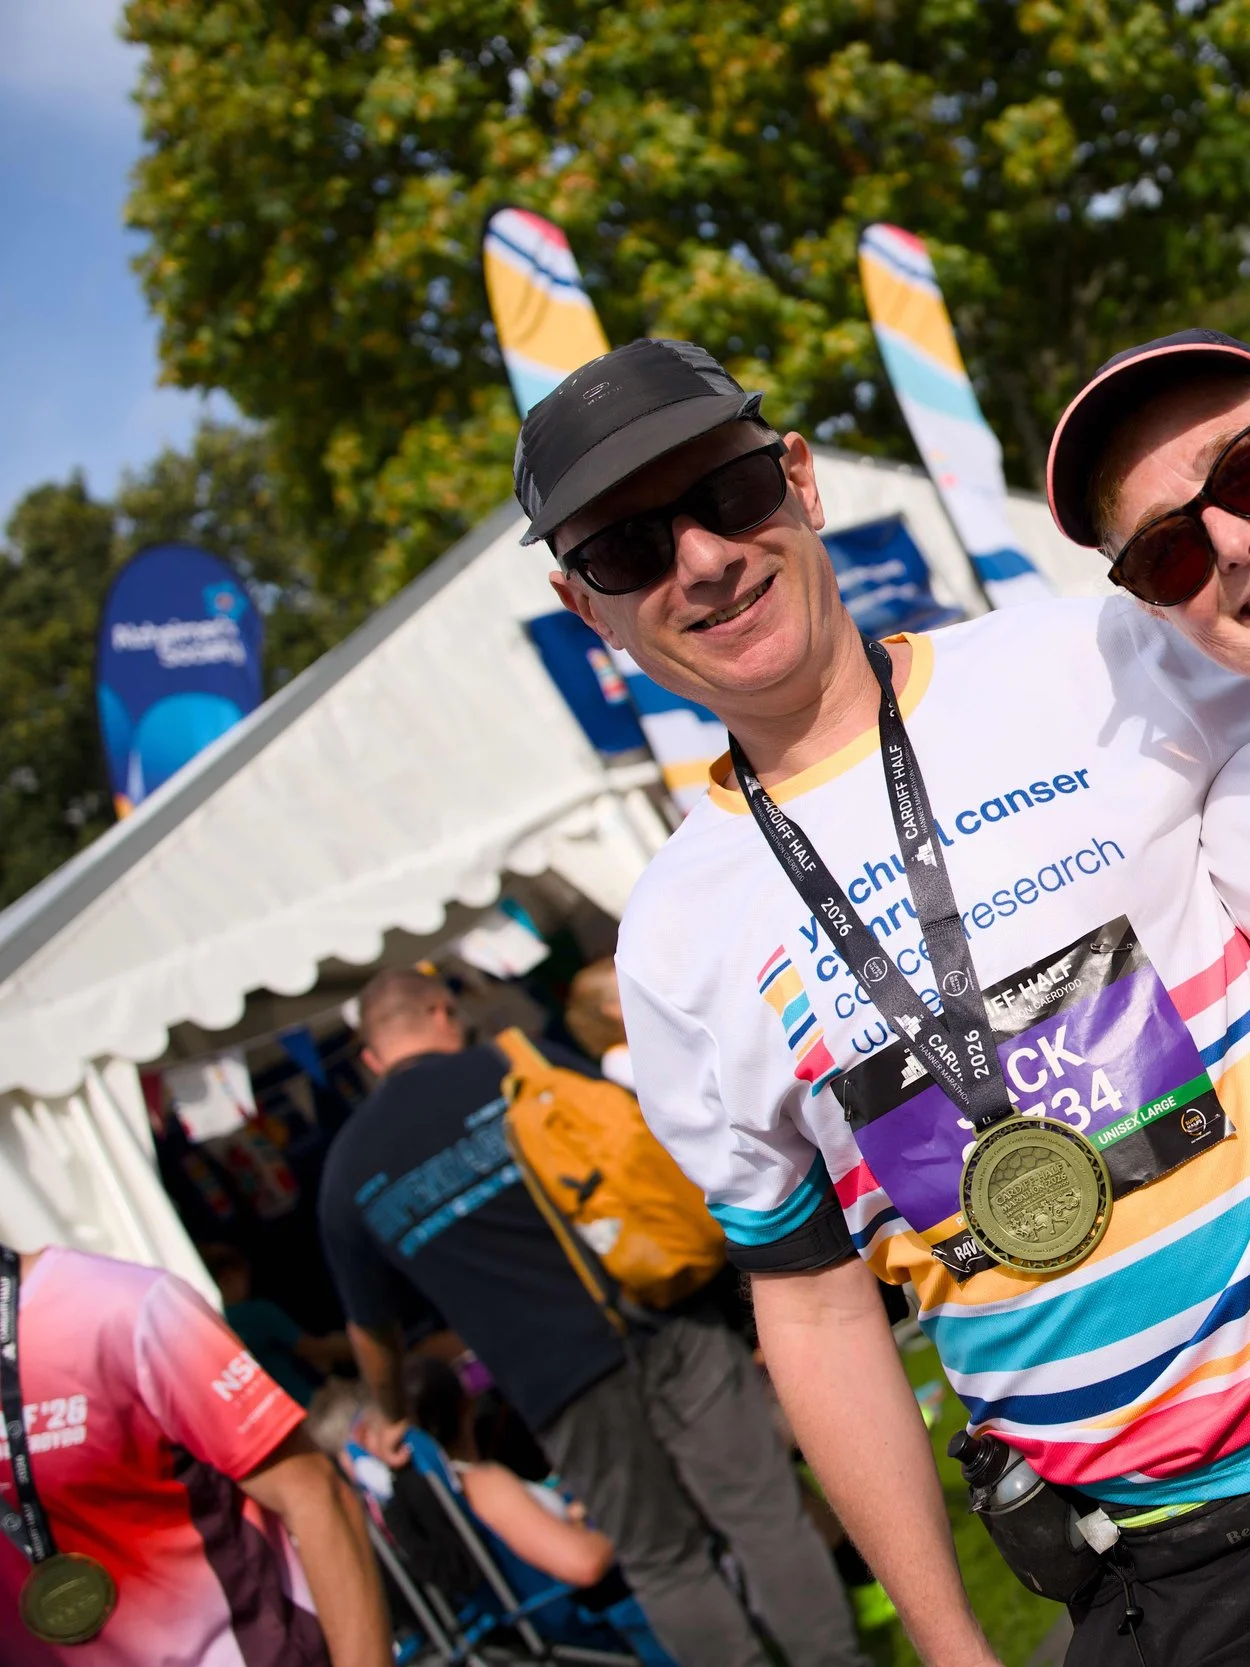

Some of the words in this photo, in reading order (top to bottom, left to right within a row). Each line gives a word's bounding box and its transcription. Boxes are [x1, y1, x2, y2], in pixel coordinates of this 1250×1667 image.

[889, 744, 907, 781] HALF
[895, 783, 919, 840] CARDIFF
[955, 767, 1090, 835] canser
[762, 795, 795, 841] CARDIFF
[788, 838, 816, 873] HALF
[820, 898, 853, 937] 2026
[1018, 963, 1073, 1001] HALF
[1034, 978, 1082, 1010] CAERDYDD
[919, 1043, 943, 1071] HANNER
[963, 1029, 990, 1079] 2026
[1098, 1112, 1141, 1145] UNISEX
[1139, 1096, 1177, 1123] LARGE
[996, 1174, 1037, 1206] CARDIFF
[1038, 1162, 1064, 1181] HALF
[1002, 1183, 1046, 1212] MARATHON
[1044, 1173, 1067, 1194] 2026
